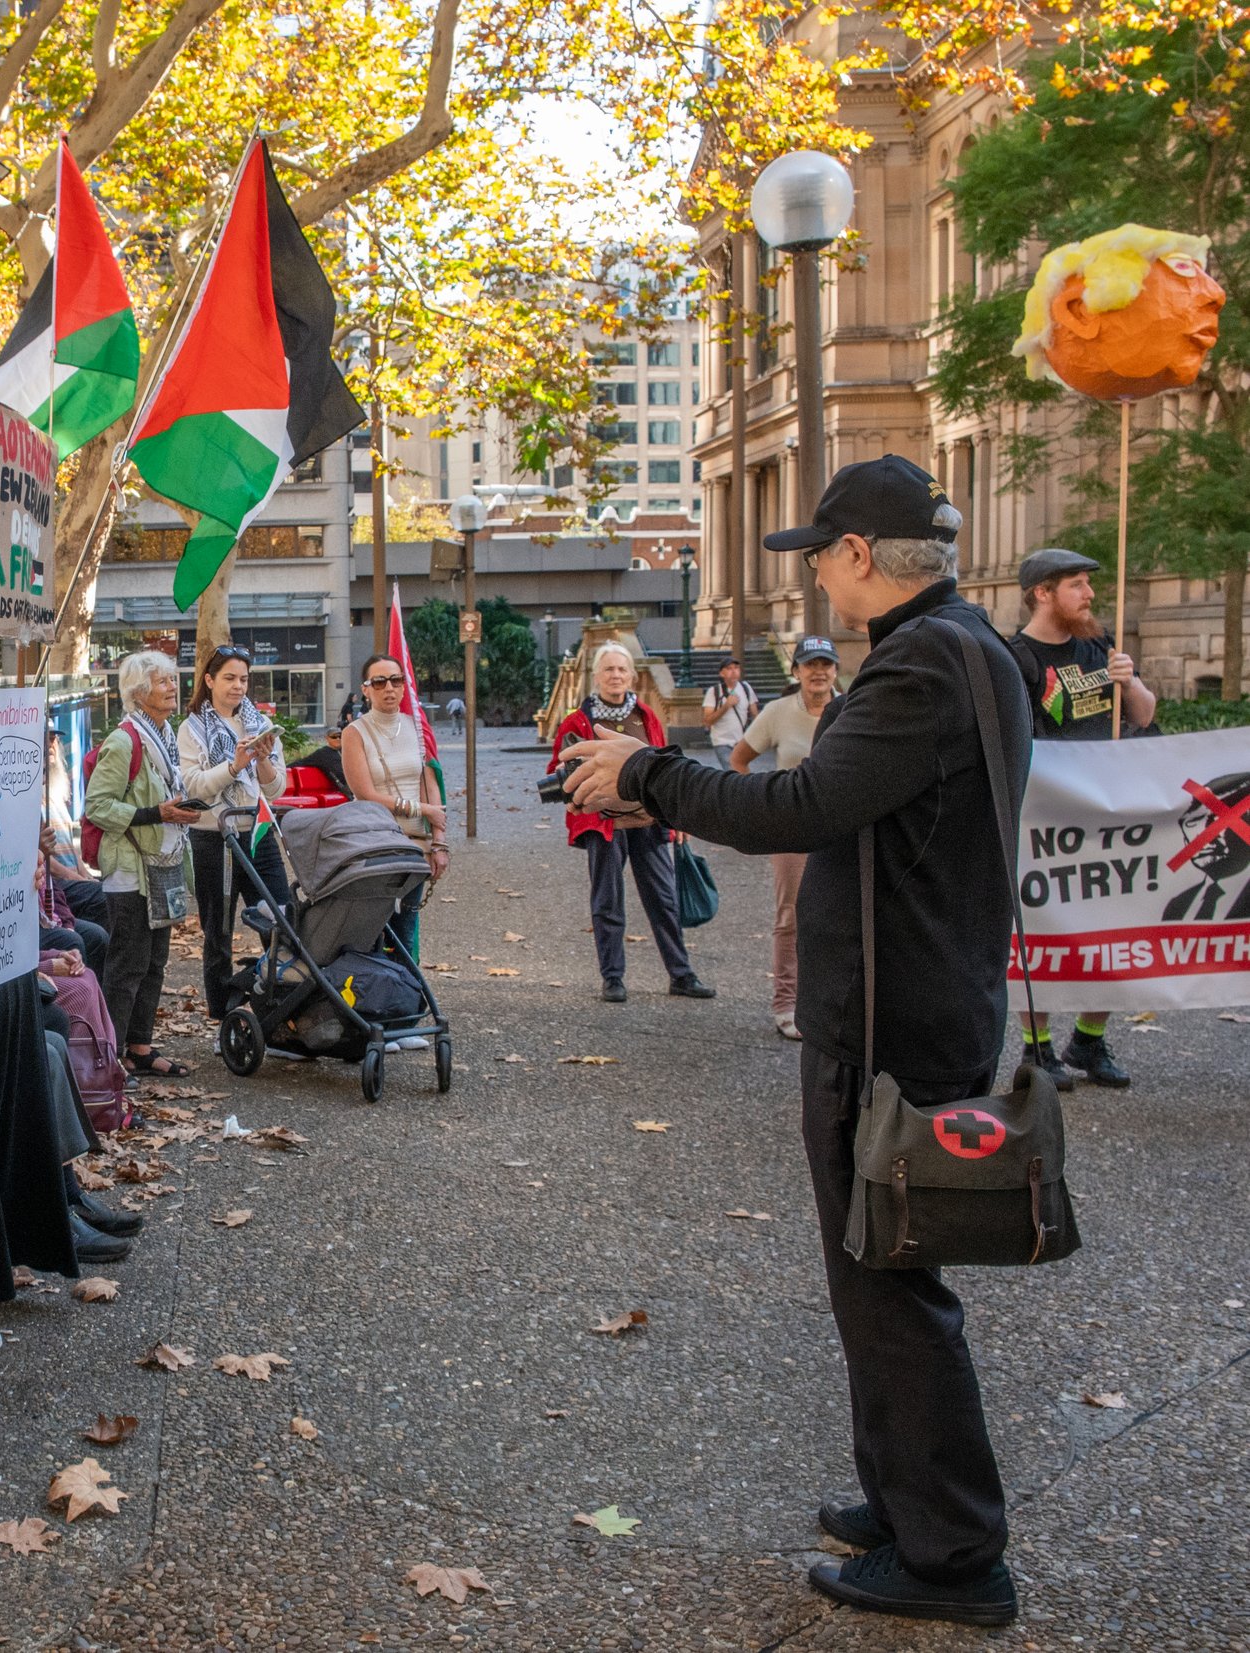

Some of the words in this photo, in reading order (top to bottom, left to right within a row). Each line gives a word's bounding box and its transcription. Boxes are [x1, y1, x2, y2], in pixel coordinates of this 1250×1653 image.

[17, 749, 39, 764] more
[1030, 826, 1085, 860] NO
[1098, 823, 1153, 850] TO
[7, 921, 17, 938] on
[1078, 940, 1154, 972] TIES
[1160, 934, 1250, 966] WITH
